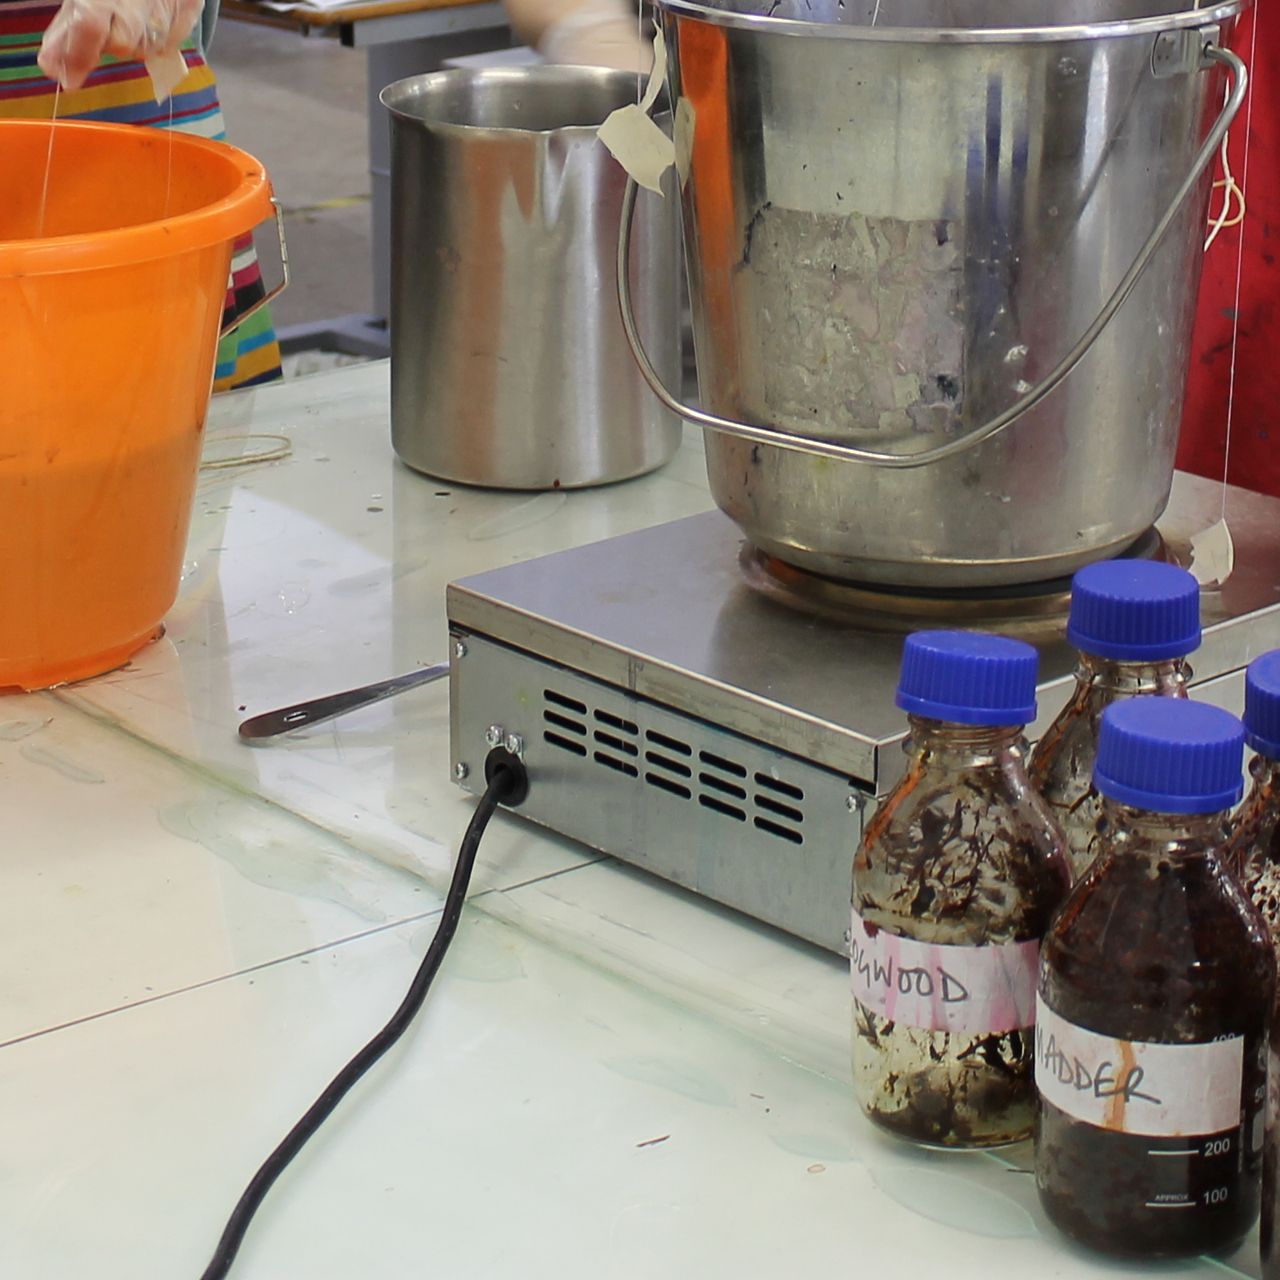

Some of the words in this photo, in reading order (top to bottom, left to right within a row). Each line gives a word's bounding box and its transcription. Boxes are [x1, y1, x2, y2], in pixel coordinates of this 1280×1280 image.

[851, 938, 969, 1003] OGWOOD
[1204, 1137, 1231, 1157] 200
[1203, 1186, 1229, 1205] 100
